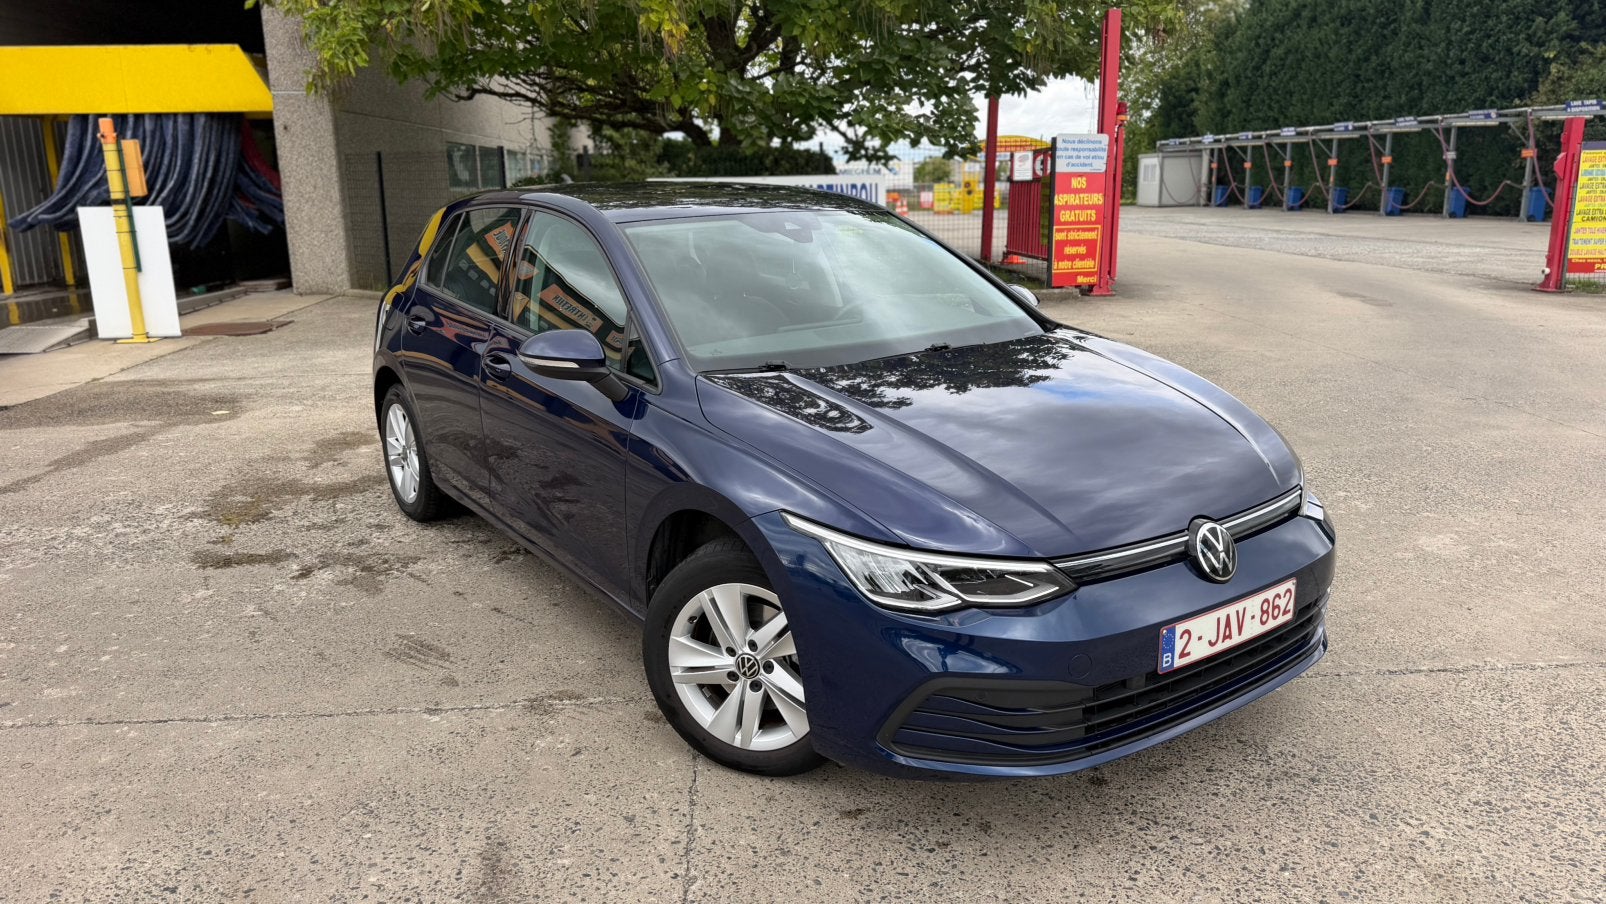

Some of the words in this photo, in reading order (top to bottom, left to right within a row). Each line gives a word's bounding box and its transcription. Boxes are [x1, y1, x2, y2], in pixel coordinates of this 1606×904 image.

[1071, 176, 1087, 189] NOS
[1054, 193, 1103, 206] ASPIRATEURS
[1060, 209, 1097, 222] GRATUITS
[1055, 230, 1067, 240] sont
[1067, 229, 1098, 240] strictement
[1064, 243, 1087, 255] réservés
[1058, 259, 1072, 269] notre
[1077, 275, 1097, 283] Merci
[1162, 653, 1172, 667] B
